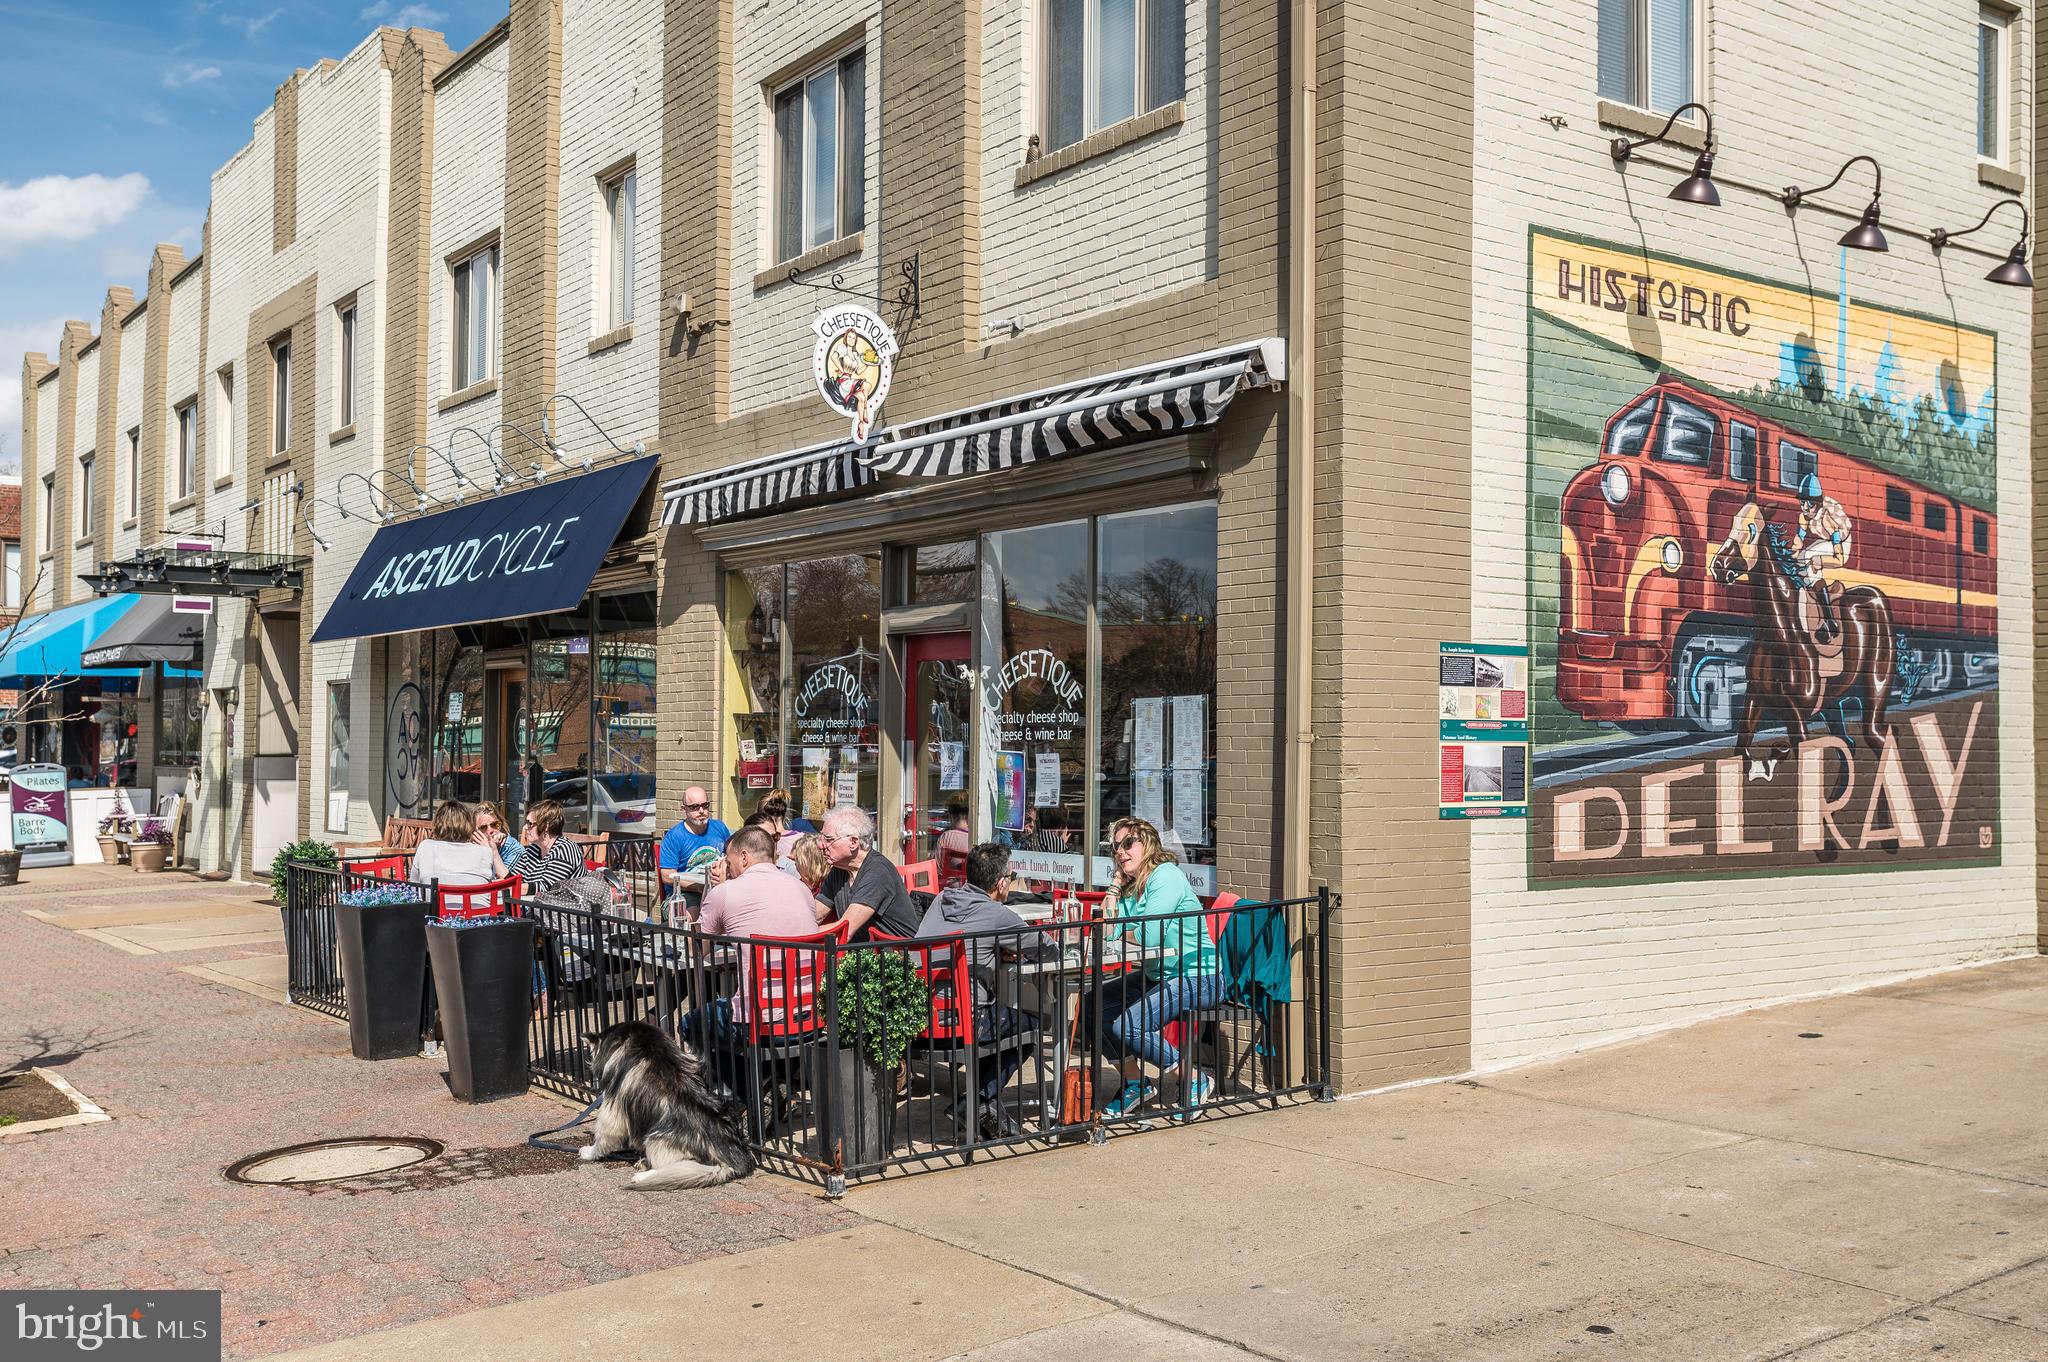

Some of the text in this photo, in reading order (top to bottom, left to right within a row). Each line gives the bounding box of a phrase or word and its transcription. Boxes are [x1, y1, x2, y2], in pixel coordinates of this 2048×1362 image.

[1558, 258, 1750, 337] HISTORIC
[820, 312, 891, 354] CHEESETIQUE
[985, 648, 1084, 711] CHEESETIQUE
[794, 664, 868, 717] CHEESETIQUE
[797, 716, 866, 731] specialty cheese shop
[995, 709, 1079, 727] ecialty cheese shop
[802, 731, 860, 743] cheese & wine bar
[1000, 727, 1073, 741] heese & wine bar
[26, 777, 60, 786] Pilates
[1553, 755, 1773, 862] DEL
[1797, 701, 1983, 852] RAY
[18, 818, 47, 827] Barre
[20, 826, 46, 836] Body
[1007, 858, 1075, 875] runch, Lunch, Dinner
